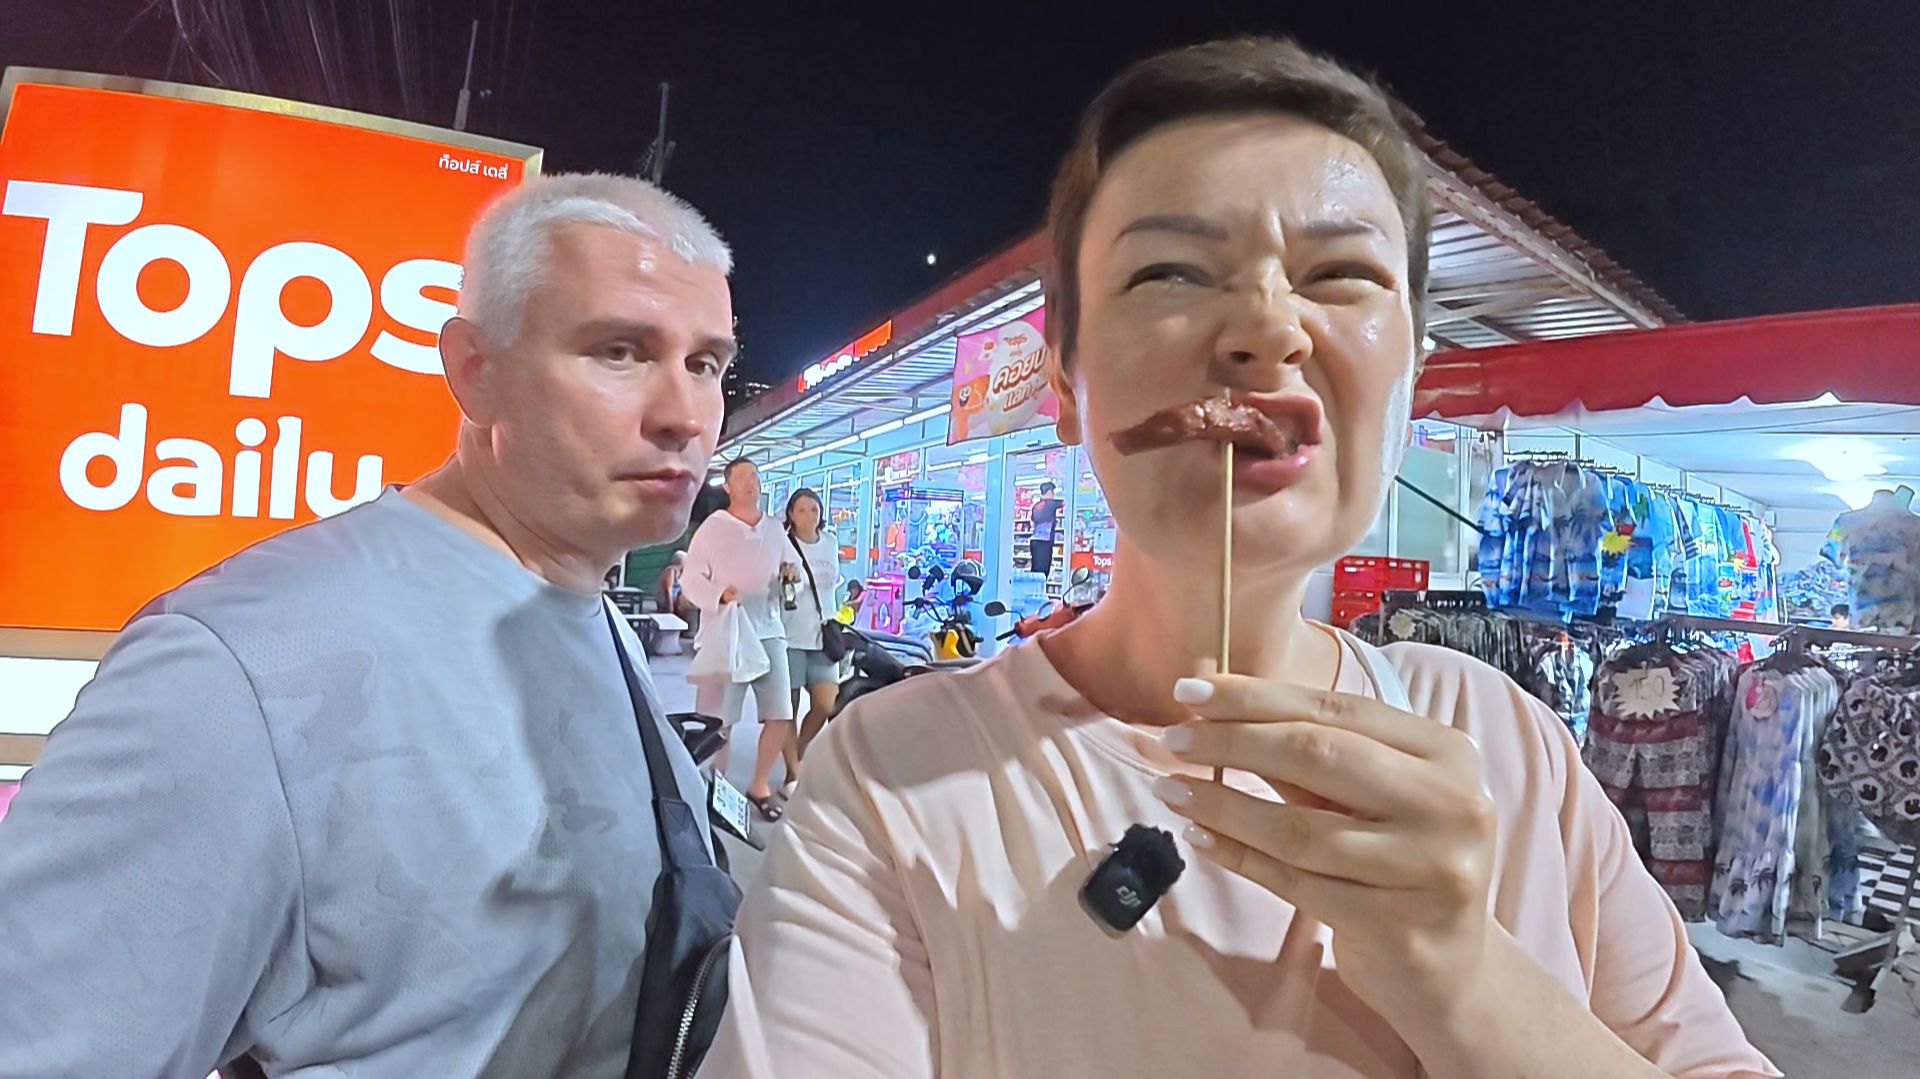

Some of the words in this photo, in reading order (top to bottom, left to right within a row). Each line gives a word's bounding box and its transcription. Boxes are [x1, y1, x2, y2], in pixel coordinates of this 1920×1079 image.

[438, 153, 482, 175] ท็อปส์
[2, 179, 465, 398] Tops
[1093, 555, 1112, 568] Tops
